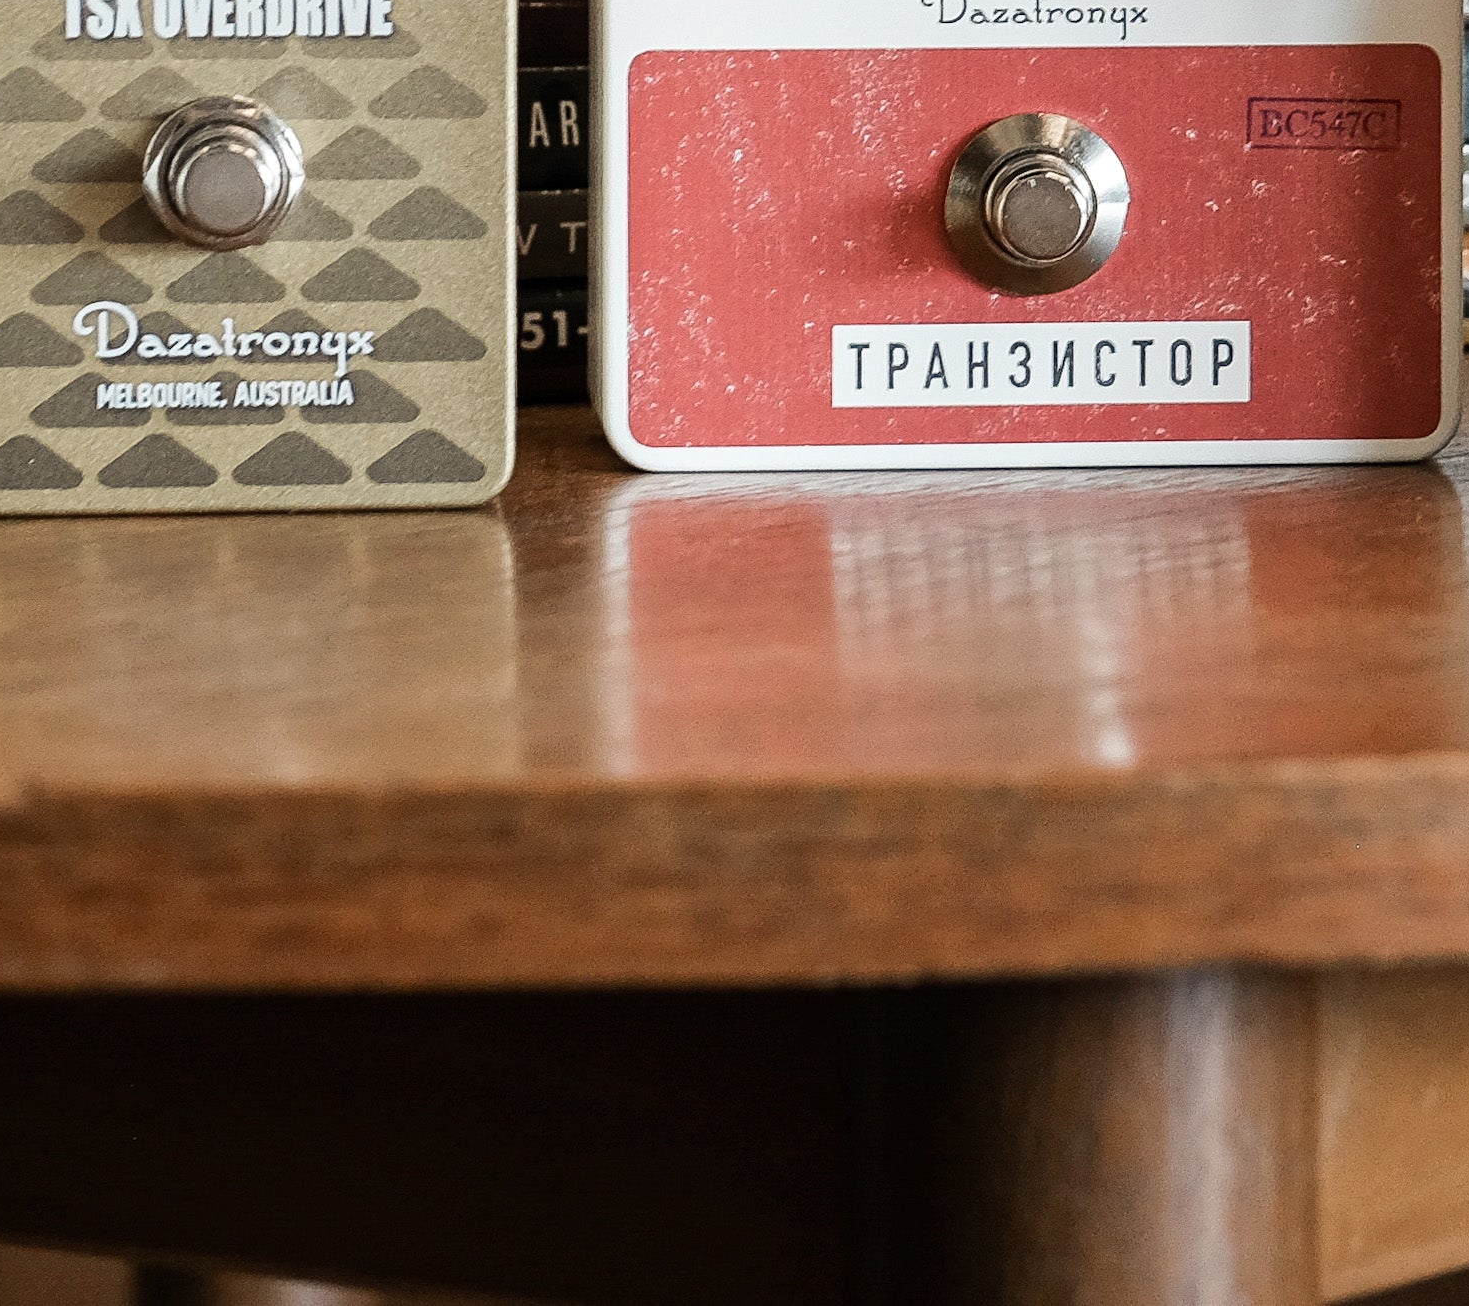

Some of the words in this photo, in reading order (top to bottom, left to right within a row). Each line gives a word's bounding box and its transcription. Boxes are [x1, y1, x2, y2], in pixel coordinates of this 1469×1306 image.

[1259, 109, 1386, 138] BC547C
[73, 301, 374, 379] Dazatronyx
[846, 338, 1236, 392] ТРАНЗИСТОР
[97, 380, 227, 409] MELBOURNE,
[234, 379, 354, 407] AUSTRALIA
